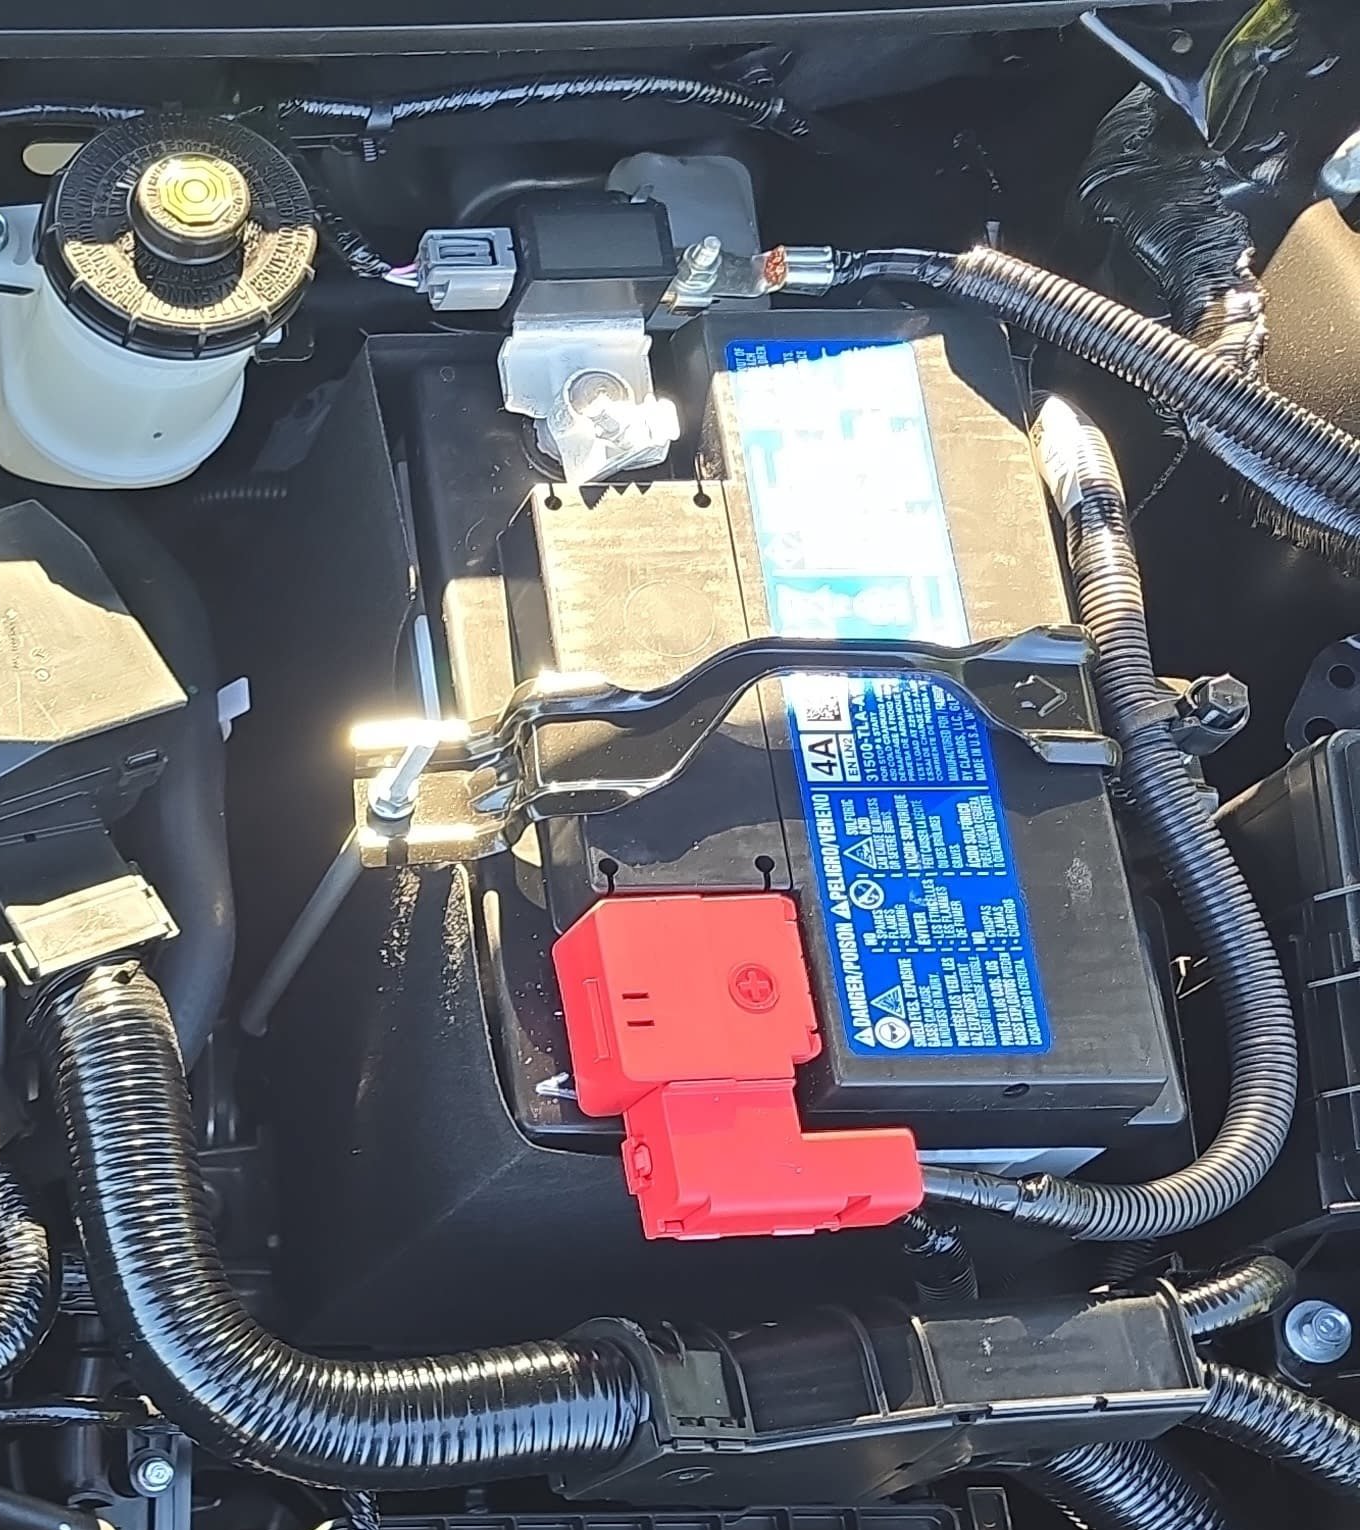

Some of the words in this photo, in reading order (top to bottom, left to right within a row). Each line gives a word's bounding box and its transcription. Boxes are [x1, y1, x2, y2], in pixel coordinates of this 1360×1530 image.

[149, 291, 252, 320] ATTENTION
[902, 691, 913, 713] AMPS
[868, 711, 881, 736] START
[915, 713, 929, 745] CHARGE
[926, 724, 935, 735] DE
[936, 715, 950, 728] FOR
[901, 738, 909, 748] DE
[909, 728, 918, 738] AT
[804, 737, 841, 775] 4A
[841, 737, 855, 758] LN2
[874, 744, 886, 764] STOP
[885, 745, 896, 767] COLD
[911, 740, 922, 760] LOAD
[921, 747, 930, 757] DE
[970, 747, 982, 756] IN
[846, 761, 859, 775] EN
[879, 765, 889, 781] FOR
[903, 750, 916, 781] PRUEBA
[915, 762, 926, 780] TEST
[961, 770, 973, 781] BY
[972, 758, 986, 780] MADE
[840, 798, 859, 835] SULFURIC
[856, 816, 872, 834] ACID
[893, 793, 914, 839] SULFURIQUE
[953, 802, 977, 843] SULFÚRICO
[811, 794, 847, 900] PELIGRO/VENENO
[872, 834, 887, 855] CAUSE
[901, 841, 919, 869] L'ACIDE
[961, 844, 981, 867] ÁCIDO
[875, 856, 889, 869] CAN
[935, 886, 953, 922] FLAMMES
[950, 900, 965, 926] FUMER
[871, 909, 888, 938] SPARKS
[883, 908, 900, 938] FLAMES
[894, 903, 911, 938] SMOKING
[909, 911, 931, 944] ÉVITER
[979, 905, 996, 937] CHISPAS
[991, 905, 1008, 937] FLAMAS
[1001, 898, 1021, 936] CIGARROS
[861, 932, 878, 945] NO
[930, 923, 944, 938] LES
[942, 923, 956, 937] LES
[955, 927, 968, 937] DE
[970, 931, 986, 944] NO
[835, 922, 871, 1026] DANGER/POISON
[940, 957, 956, 970] LES
[984, 960, 1000, 974] LOS
[897, 958, 918, 998] EXPLOSIVE
[987, 975, 1005, 997] OJOS.
[918, 985, 933, 1007] CAUSE
[946, 993, 963, 1008] LES
[992, 998, 1007, 1011] LOS
[905, 999, 922, 1020] EYES.
[922, 1008, 936, 1022] CAN
[961, 992, 981, 1030] EXPLOSIFS
[909, 1021, 927, 1047] SHIELD
[923, 1023, 941, 1047] GASES
[969, 1032, 985, 1045] GAZ
[994, 1012, 1014, 1045] PROTEJA
[1010, 1022, 1029, 1045] GASES
[1024, 1018, 1043, 1044] CAUSAR
